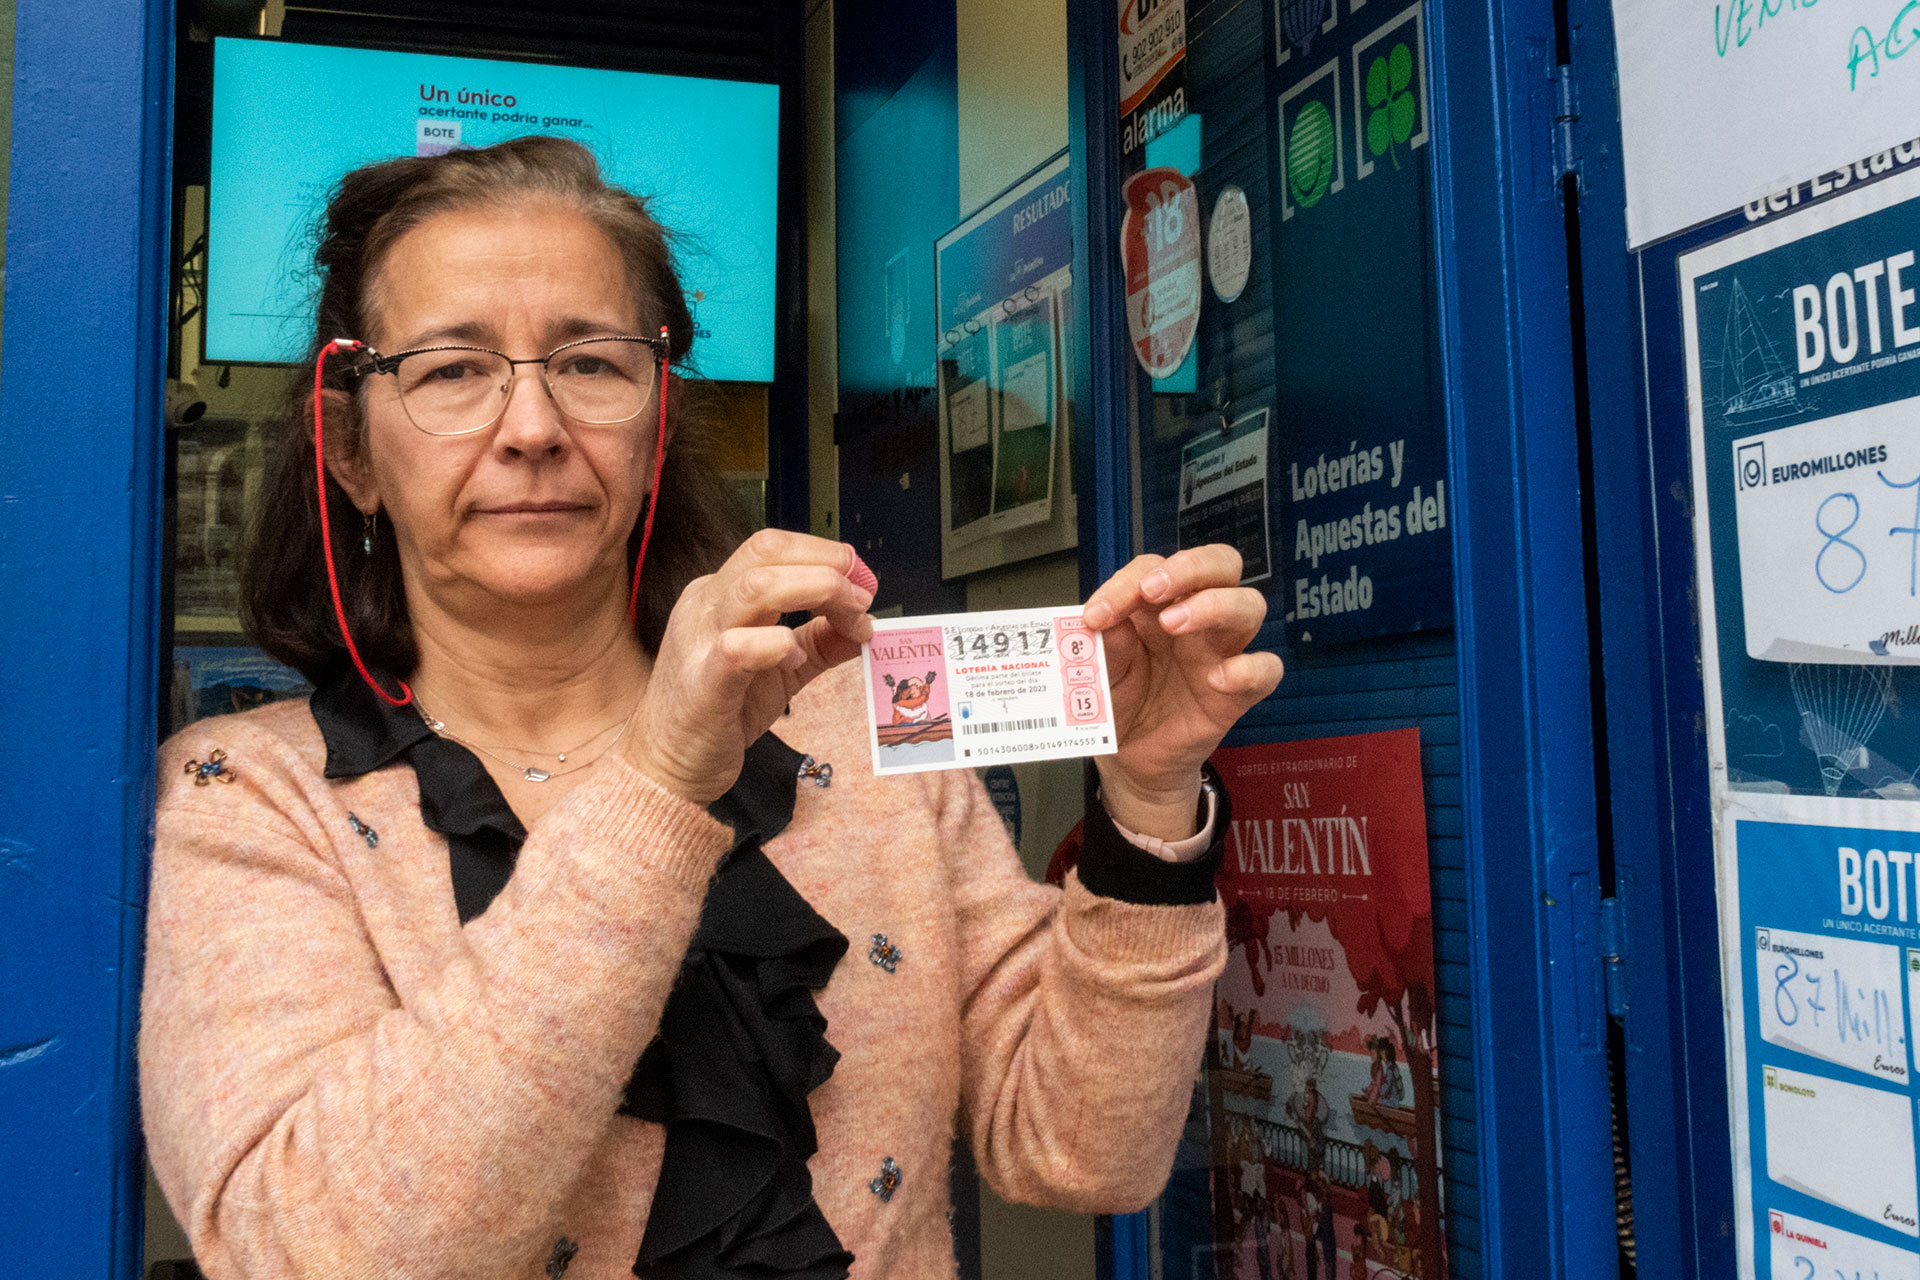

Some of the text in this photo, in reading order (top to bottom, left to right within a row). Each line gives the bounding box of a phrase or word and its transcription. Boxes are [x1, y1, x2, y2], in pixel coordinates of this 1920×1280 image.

[1132, 38, 1146, 64] 902
[1148, 24, 1163, 51] 902
[1166, 10, 1180, 37] 910
[420, 84, 518, 108] Un único
[418, 106, 488, 121] acertante
[1123, 86, 1186, 154] alarma
[424, 127, 456, 138] BOTE
[1792, 249, 1920, 375] BOTE
[1800, 378, 1810, 388] UN
[1832, 361, 1871, 380] ACERTANTE
[1291, 439, 1404, 502] Loterías y
[1772, 444, 1888, 484] EUROMILLONES
[1295, 502, 1402, 568] Apuestas
[1405, 480, 1446, 535] del
[1296, 565, 1374, 620] Estado
[953, 628, 1051, 656] 14917
[1880, 624, 1920, 648] Mill
[872, 642, 942, 661] VALENTÍN
[956, 660, 1051, 675] LOTERÍA NACIONAL
[991, 672, 1008, 680] parte
[965, 684, 1047, 698] 18 de febrero de 2023
[1076, 698, 1092, 710] 15
[1236, 756, 1358, 778] SORTEO EXTRAORDINARIO DE
[1284, 781, 1310, 809] SAN
[1231, 804, 1372, 876] VALENTÍN
[1265, 887, 1338, 902] 18 DE FEBRERO
[1838, 846, 1920, 923] BOT
[1822, 918, 1834, 929] UN
[1864, 924, 1916, 940] ACERTANTE
[1286, 943, 1336, 971] MILLONES
[1772, 944, 1824, 960] EUROMILLONES
[1874, 1055, 1906, 1076] Euros
[1779, 1083, 1816, 1098] BONOLOTO
[1883, 1204, 1916, 1228] Euros
[1786, 1229, 1794, 1240] LA
